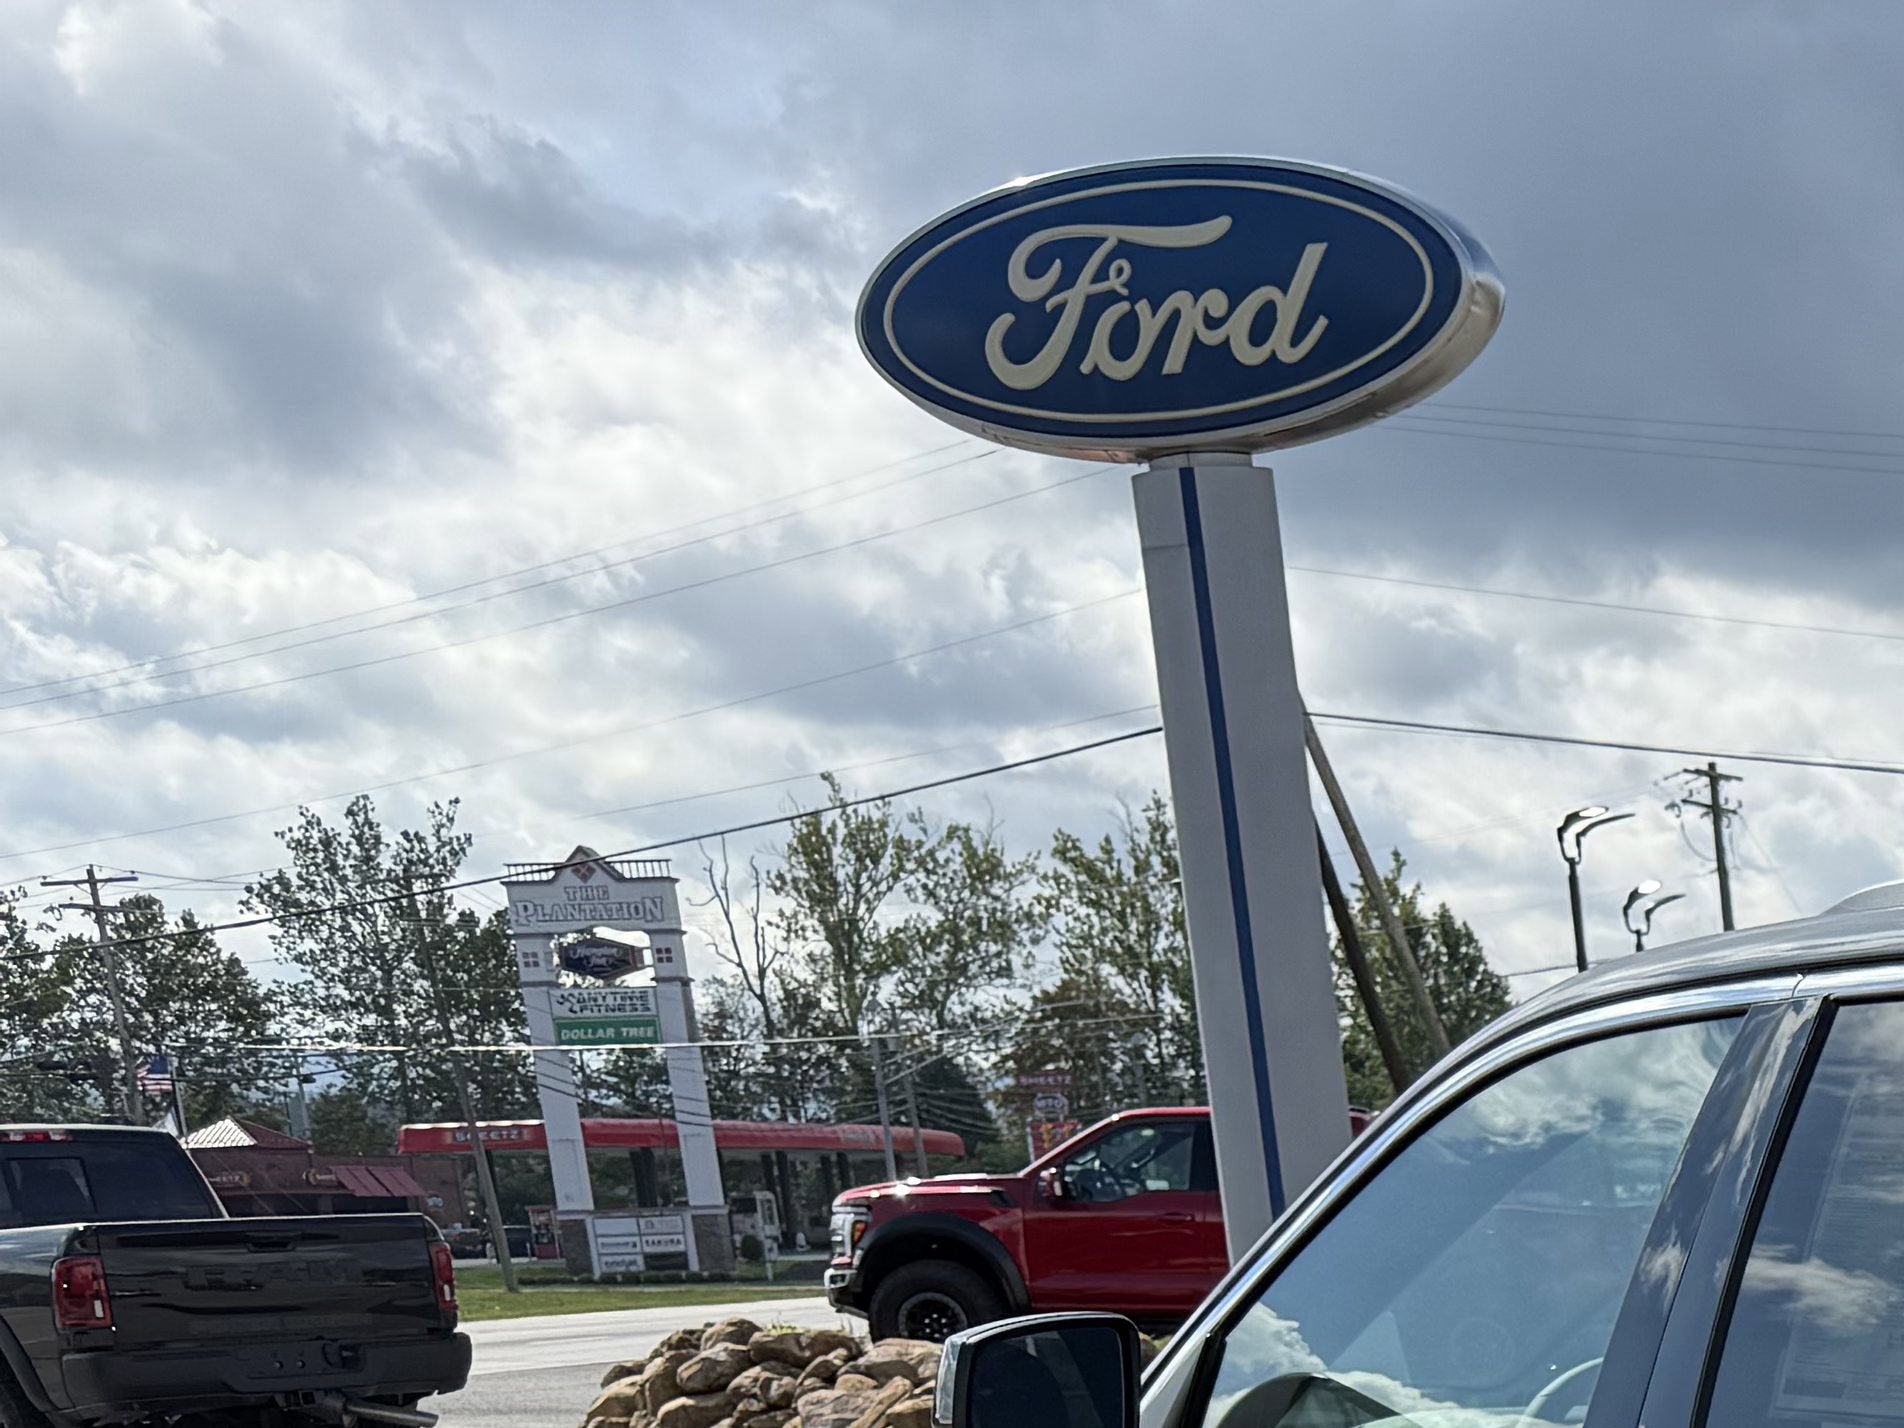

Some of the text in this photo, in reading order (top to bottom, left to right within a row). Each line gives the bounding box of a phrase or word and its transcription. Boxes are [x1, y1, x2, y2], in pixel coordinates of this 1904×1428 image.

[985, 215, 1329, 390] Ford
[564, 885, 610, 901] THE
[577, 990, 649, 1004] ANYTIME
[579, 1003, 651, 1014] FITNESS
[561, 1025, 655, 1040] DOLLAR TREE
